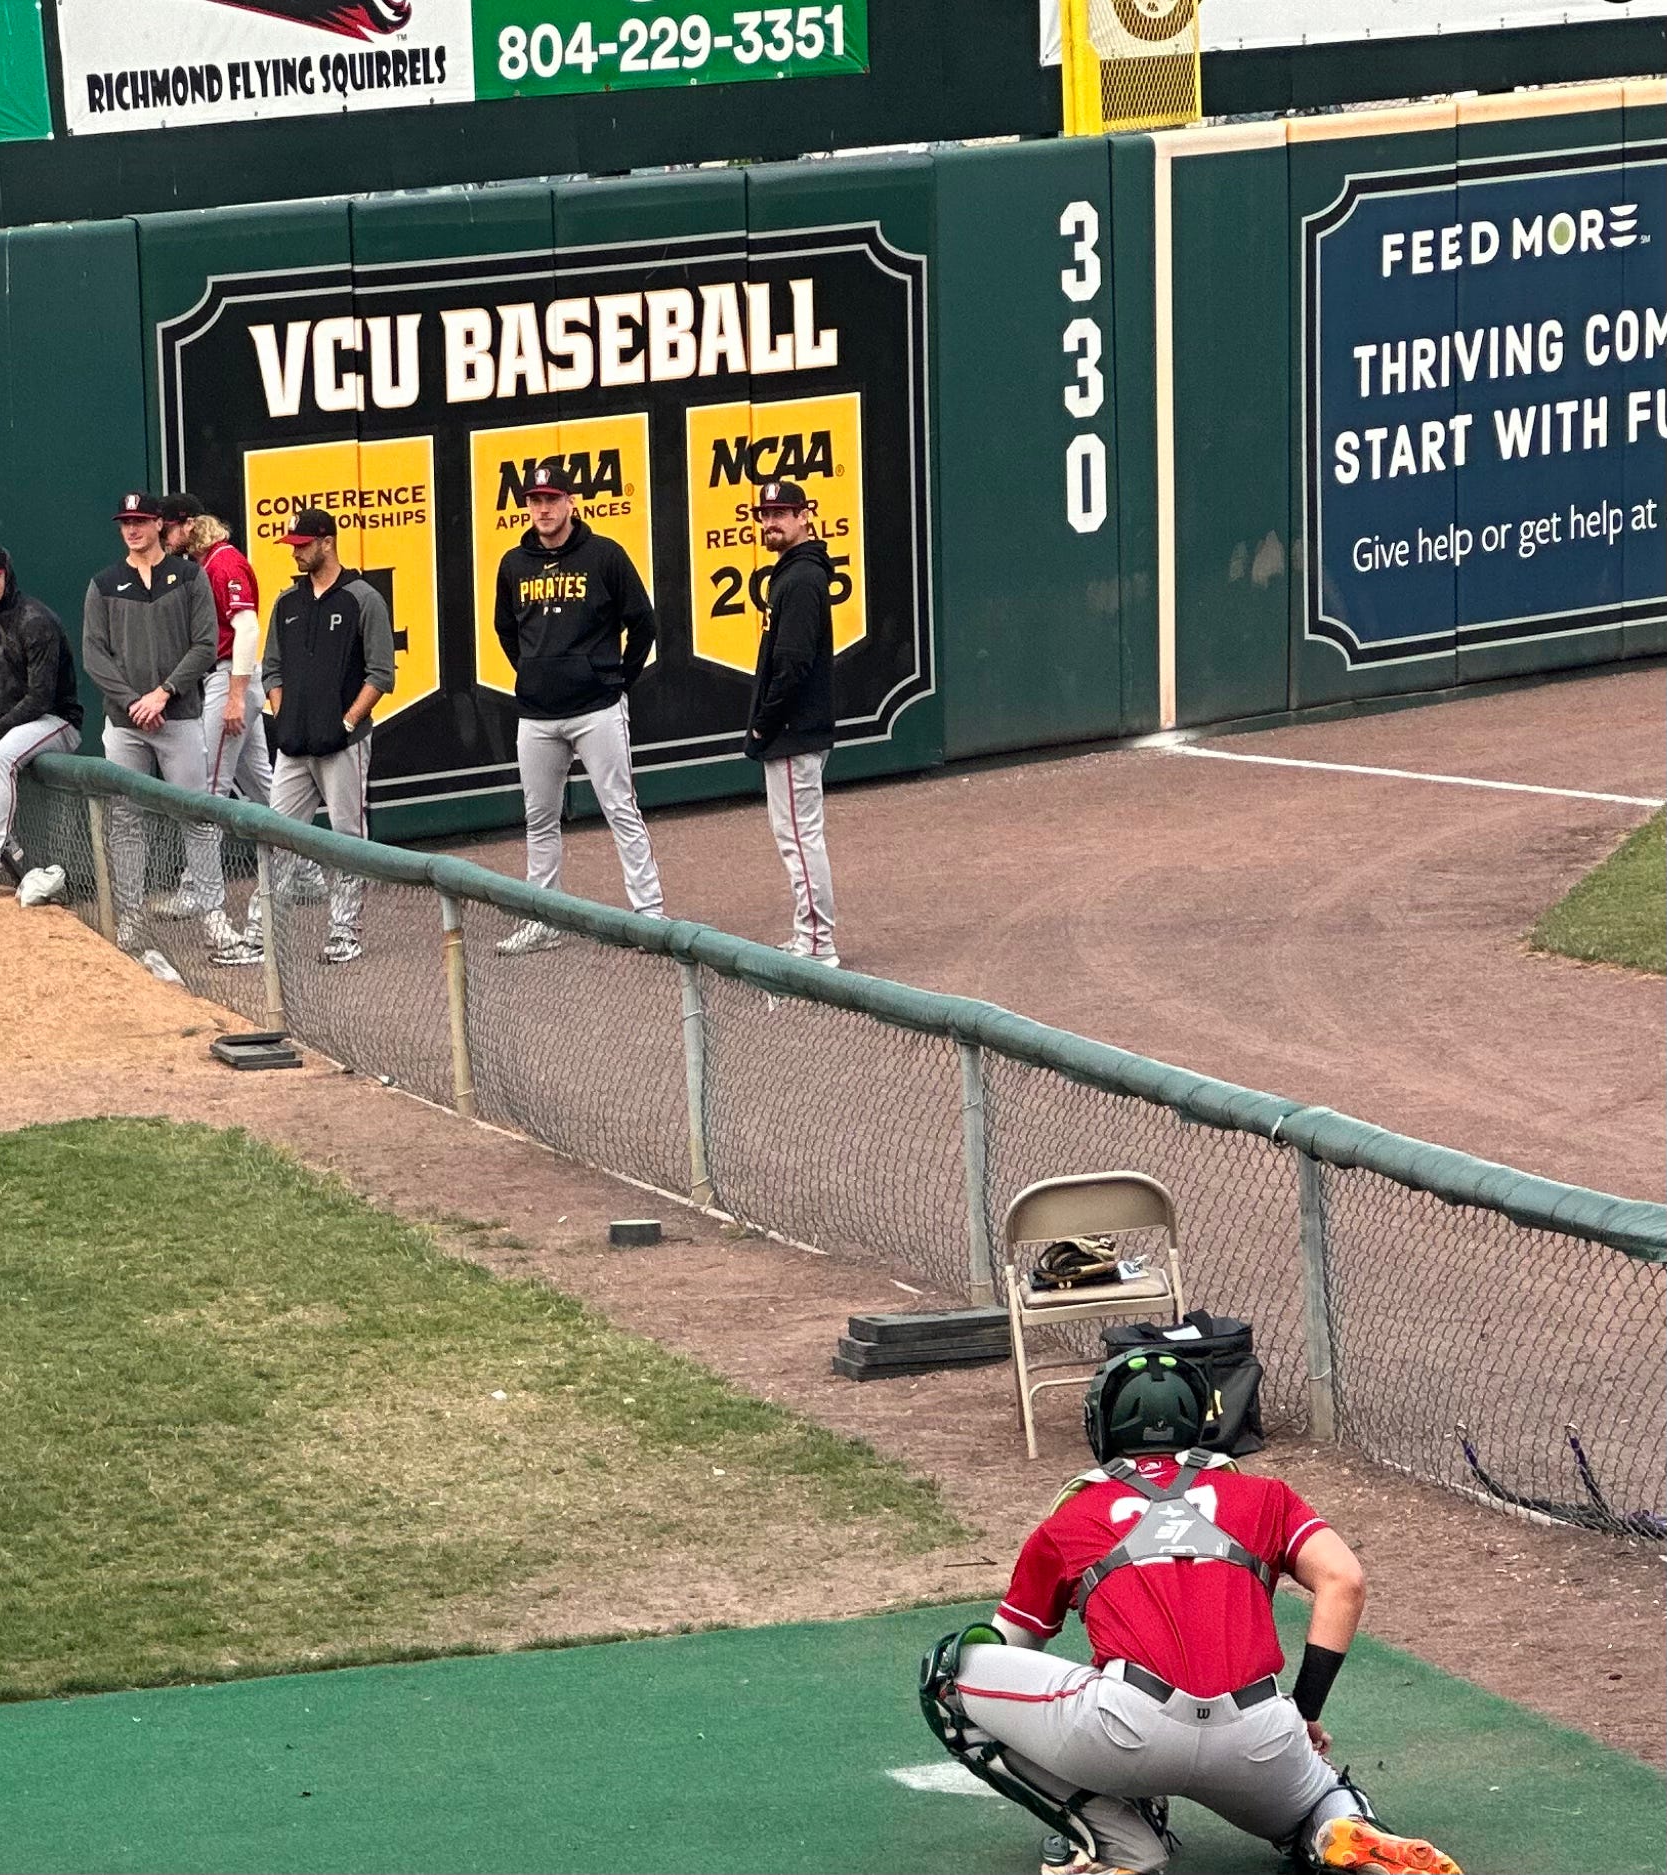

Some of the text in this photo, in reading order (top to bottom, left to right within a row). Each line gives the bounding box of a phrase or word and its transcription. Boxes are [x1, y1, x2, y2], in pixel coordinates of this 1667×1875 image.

[498, 4, 845, 81] 804-229-3351
[86, 45, 447, 114] RICHMOND FLYING SQUIRRELS
[1381, 219, 1501, 278] FEED
[1511, 203, 1639, 261] MORE
[247, 277, 839, 419] VCU BASEBALL
[1353, 306, 1667, 398] THRIVING COM
[708, 429, 835, 488] NCAA
[1334, 412, 1473, 485] START
[1492, 395, 1609, 461] WITH
[255, 484, 427, 517] CONFERENCE
[256, 509, 427, 539] CHONSHIPS
[495, 501, 632, 531] APPANCES
[706, 517, 850, 549] REGIALS
[1353, 498, 1658, 573] Give help or get help at
[519, 576, 588, 603] PIRATES
[710, 552, 853, 619] 205
[329, 614, 343, 631] P
